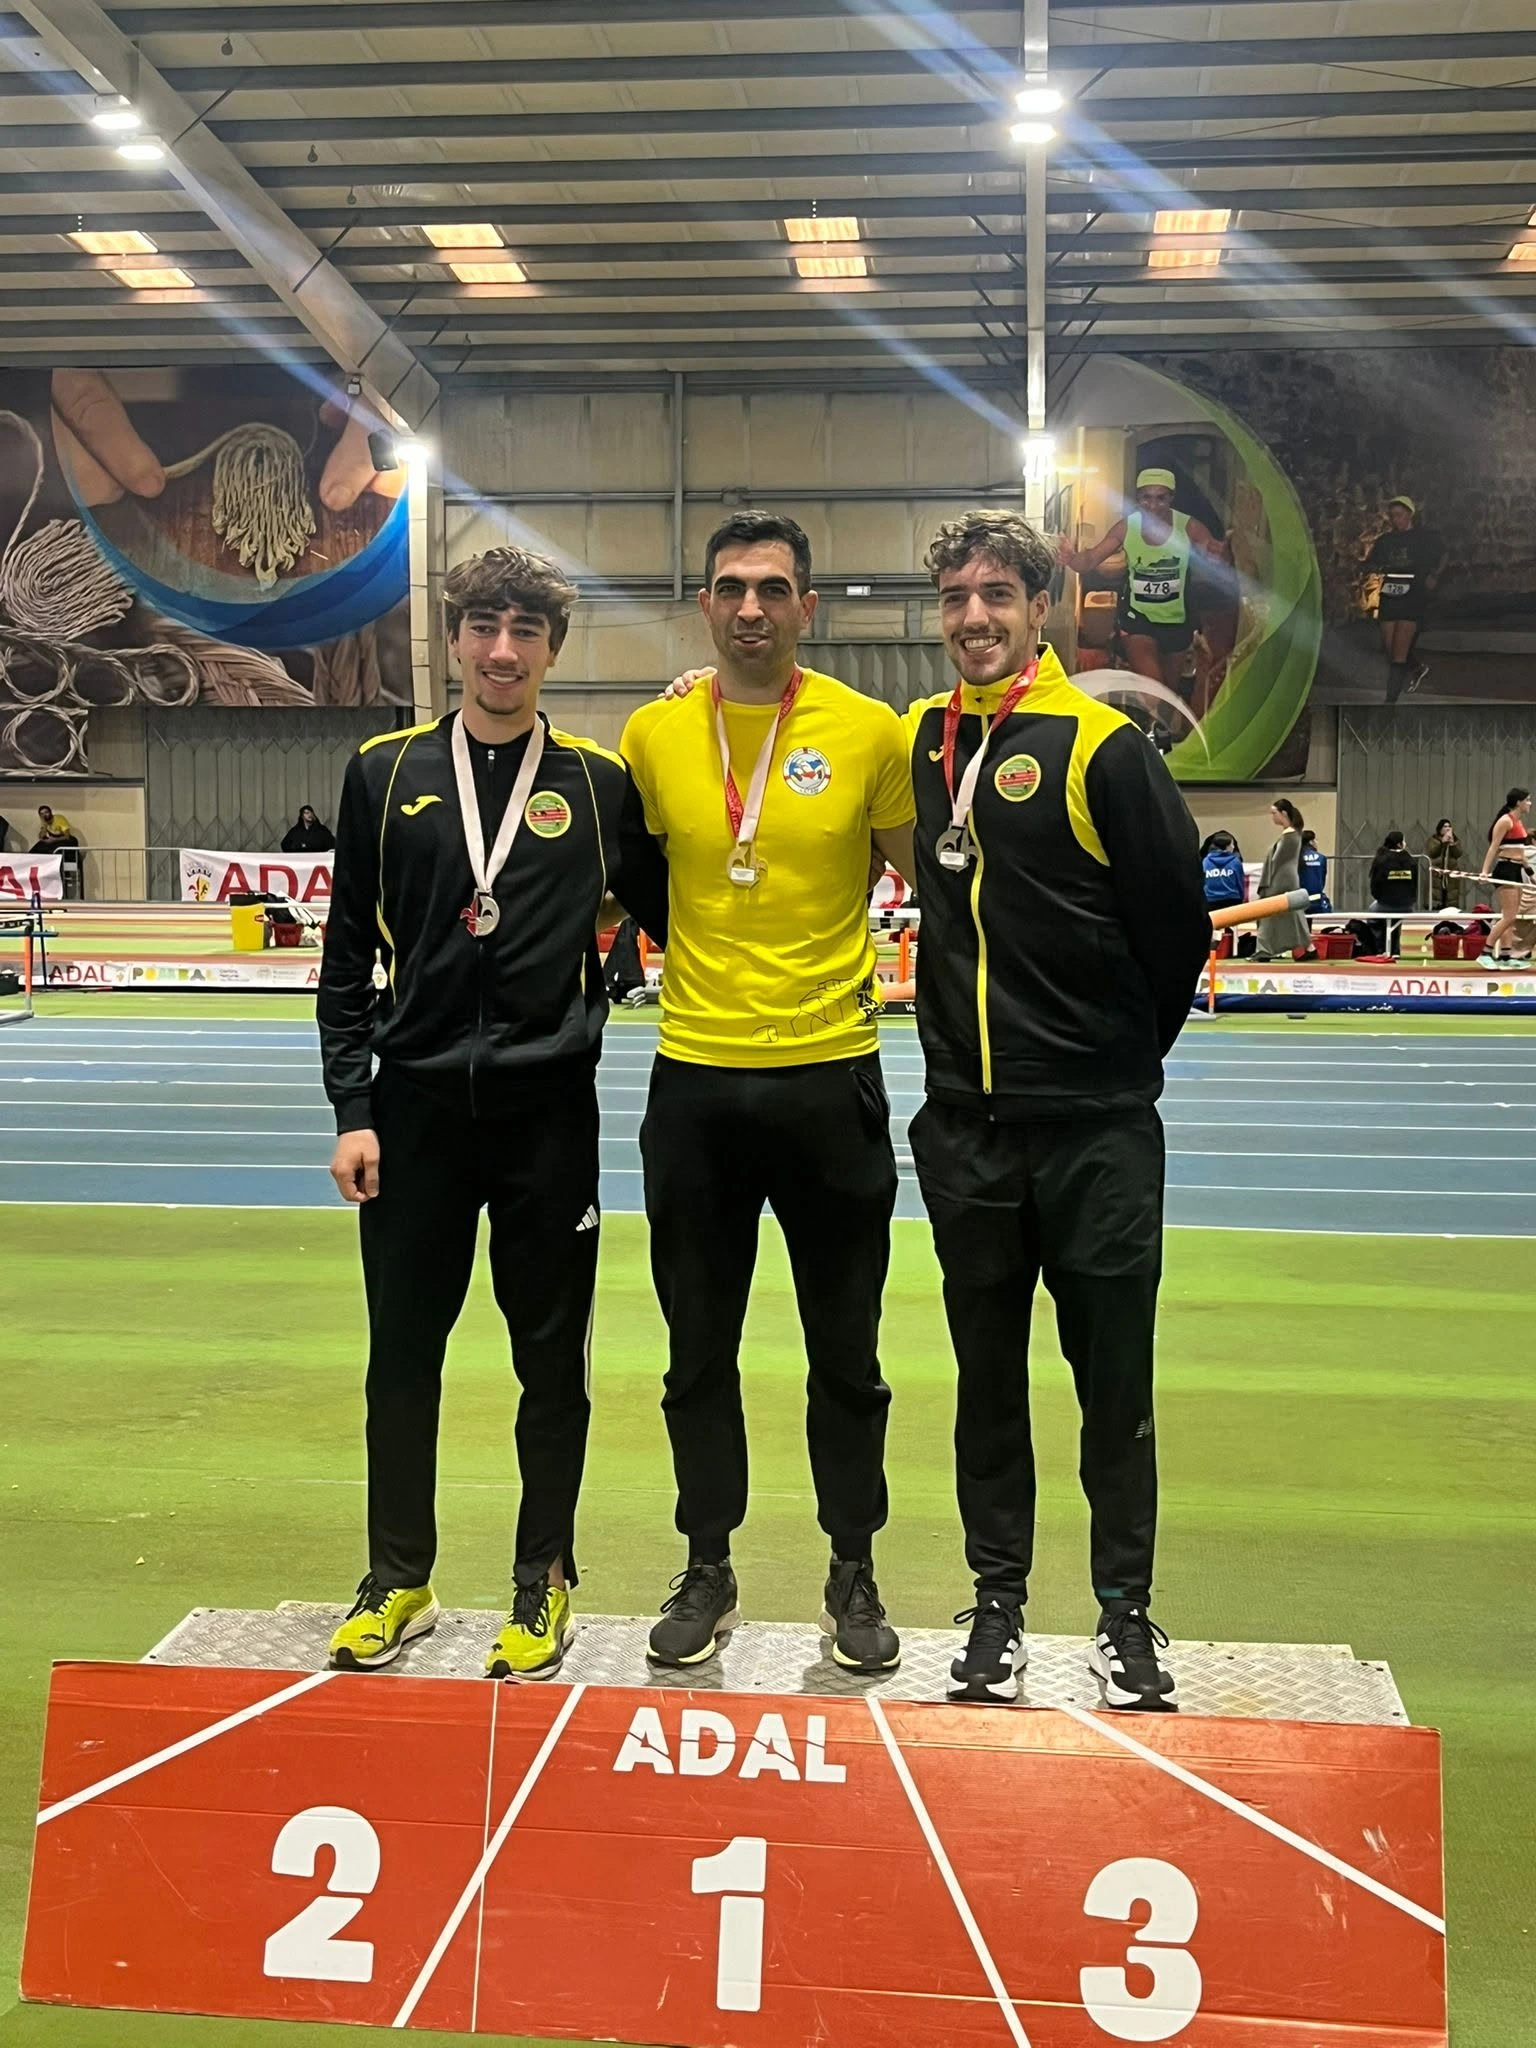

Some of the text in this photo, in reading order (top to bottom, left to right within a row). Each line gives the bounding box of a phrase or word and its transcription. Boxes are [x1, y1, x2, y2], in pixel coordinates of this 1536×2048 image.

[1143, 582, 1170, 595] 478
[1205, 868, 1234, 878] NDAP
[50, 965, 113, 983] ADAL
[133, 967, 217, 981] POMBAL
[613, 1707, 848, 1783] ADAL
[264, 1807, 381, 1983] 2
[691, 1837, 767, 2011] 1
[1079, 1858, 1202, 2042] 3
